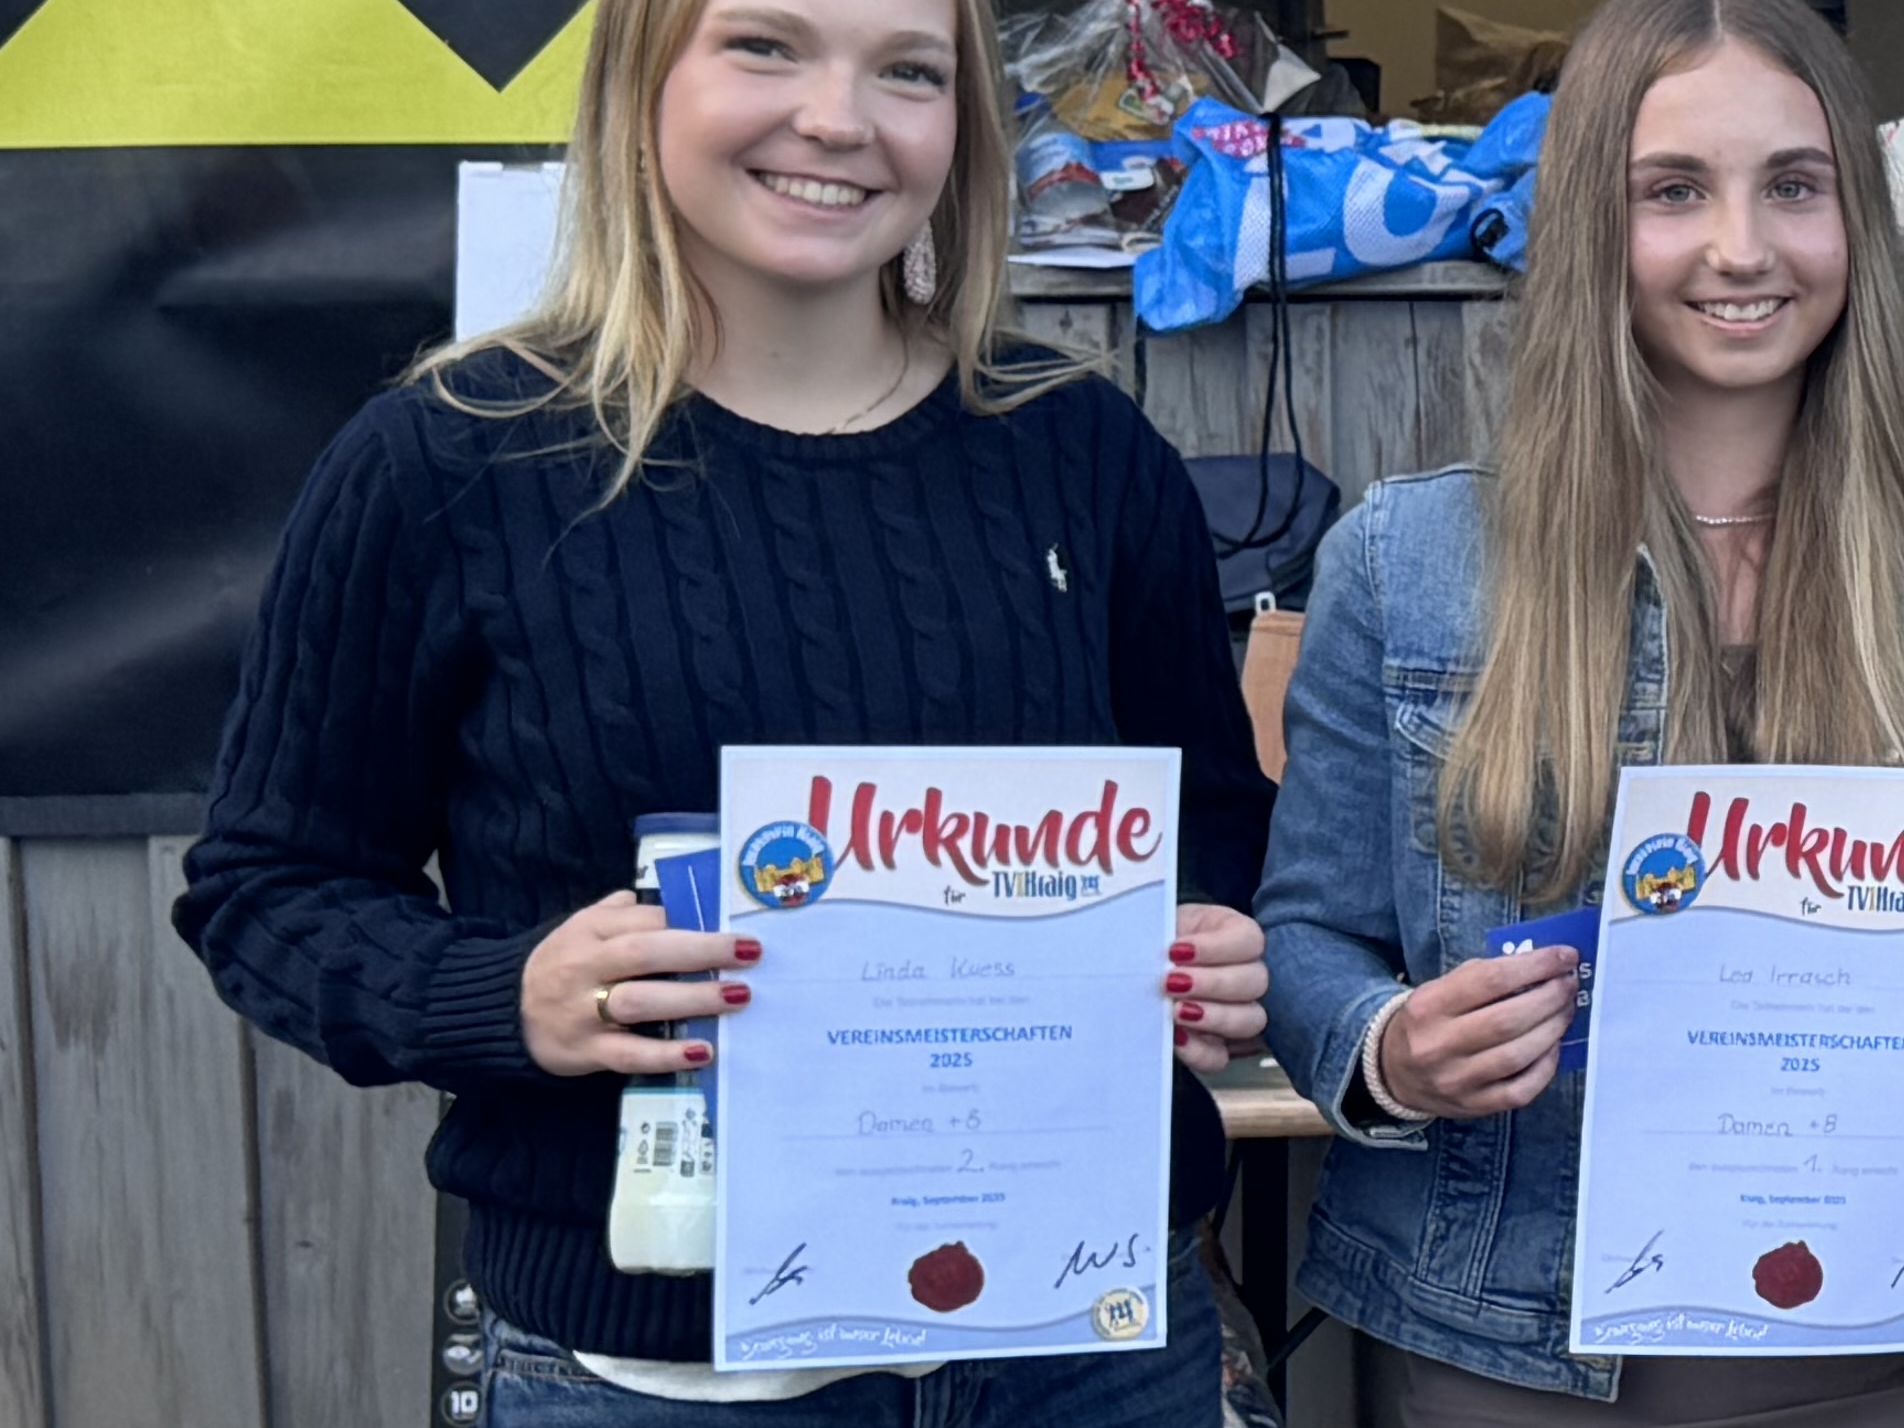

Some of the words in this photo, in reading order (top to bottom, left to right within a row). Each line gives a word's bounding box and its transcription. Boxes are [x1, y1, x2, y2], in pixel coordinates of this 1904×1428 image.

[808, 775, 1162, 886] Urkunde
[827, 1025, 1073, 1046] VEREINSMEISTERSCHAFTEN
[929, 1052, 973, 1068] 2025
[857, 1109, 936, 1137] Damen
[1717, 1113, 1793, 1137] Damen
